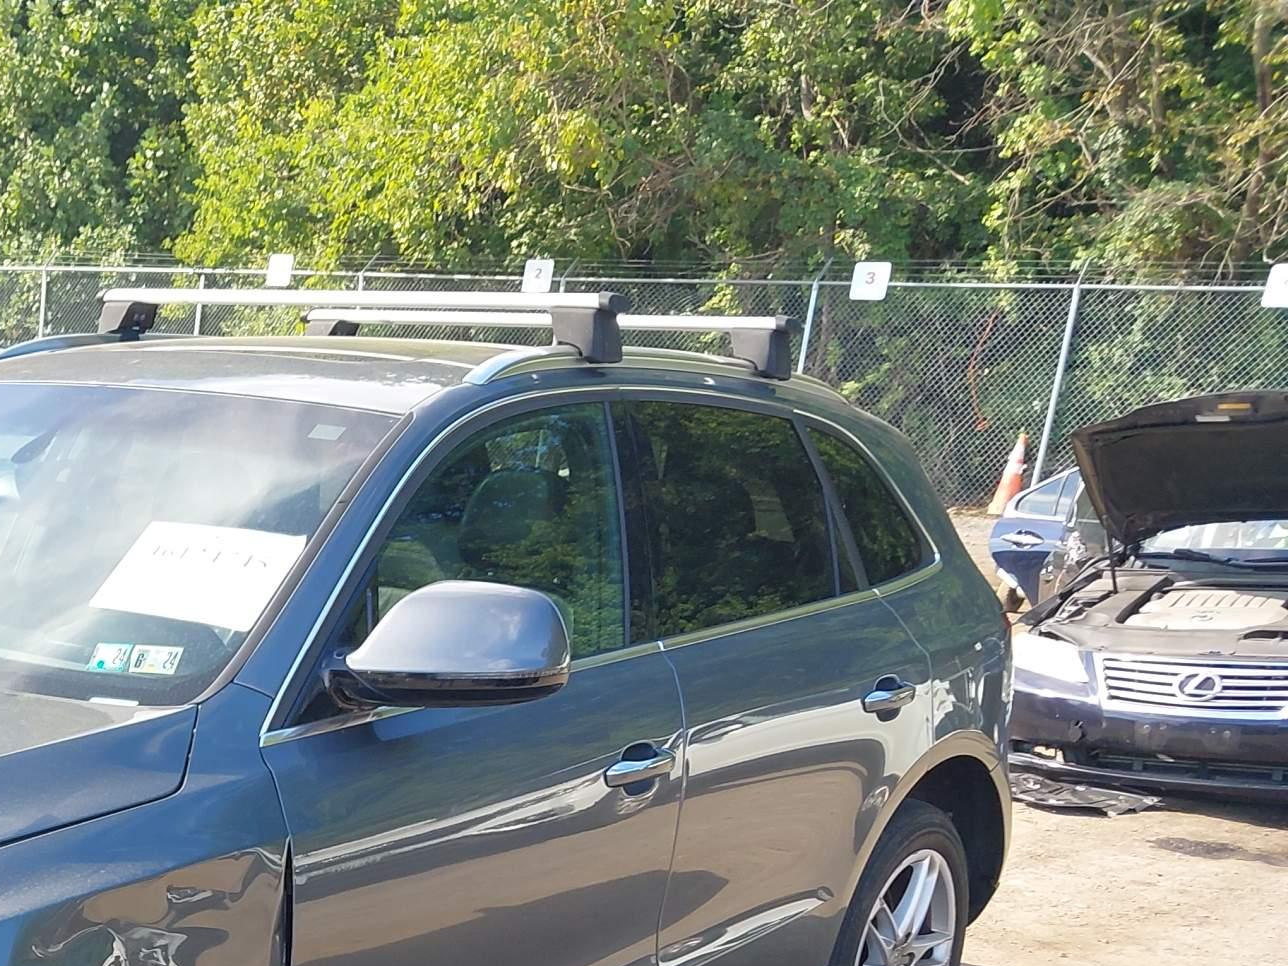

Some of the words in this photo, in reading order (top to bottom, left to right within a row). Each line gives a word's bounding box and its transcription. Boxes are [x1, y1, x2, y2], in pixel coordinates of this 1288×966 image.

[535, 268, 542, 279] 2
[865, 271, 876, 285] 3
[163, 651, 179, 670] 24
